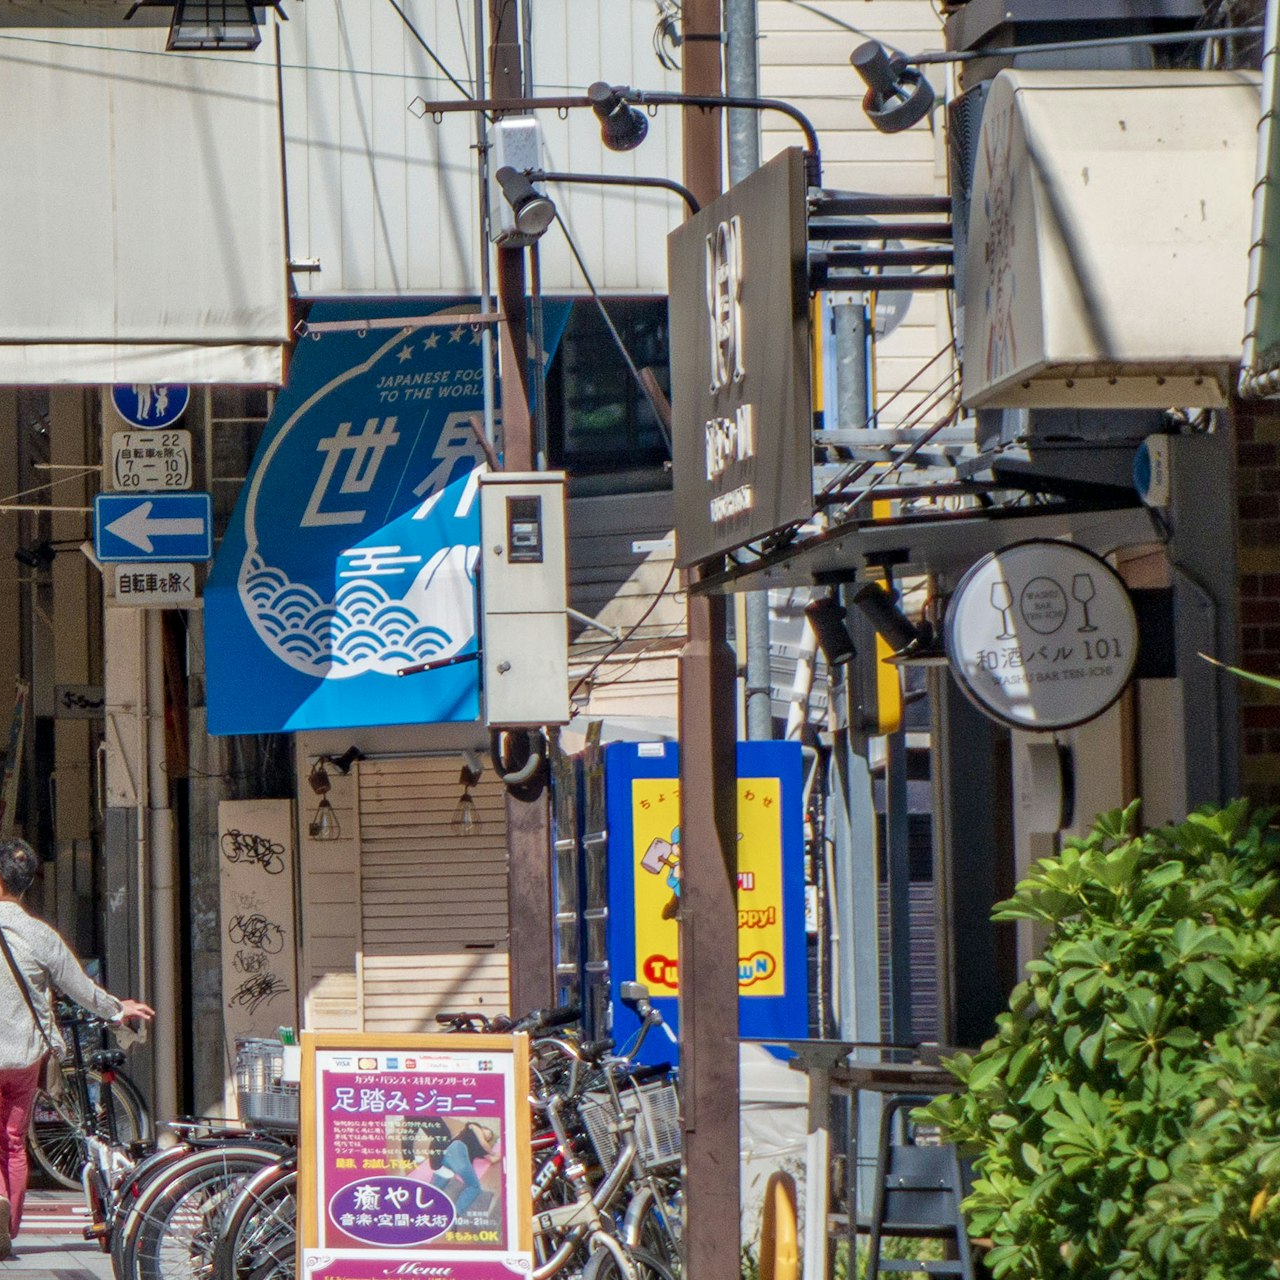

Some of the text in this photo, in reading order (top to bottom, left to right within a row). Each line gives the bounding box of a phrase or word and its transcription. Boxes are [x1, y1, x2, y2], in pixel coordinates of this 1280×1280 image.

[376, 370, 451, 389] JAPANESE
[380, 382, 486, 403] TO THE WORL
[162, 434, 180, 447] 22
[165, 460, 179, 472] 10
[122, 474, 140, 487] 20
[165, 474, 184, 486] 22
[119, 572, 191, 594] 自転車を除く
[976, 637, 1123, 672] 和酒バル 101
[335, 1060, 351, 1068] VISA
[330, 1086, 496, 1113] 足踏みジョニー
[353, 1184, 434, 1211] 癒やし
[339, 1212, 449, 1228] 音楽・空間・技術
[445, 1230, 499, 1242] 手もみもOK
[382, 1261, 453, 1276] Menu
